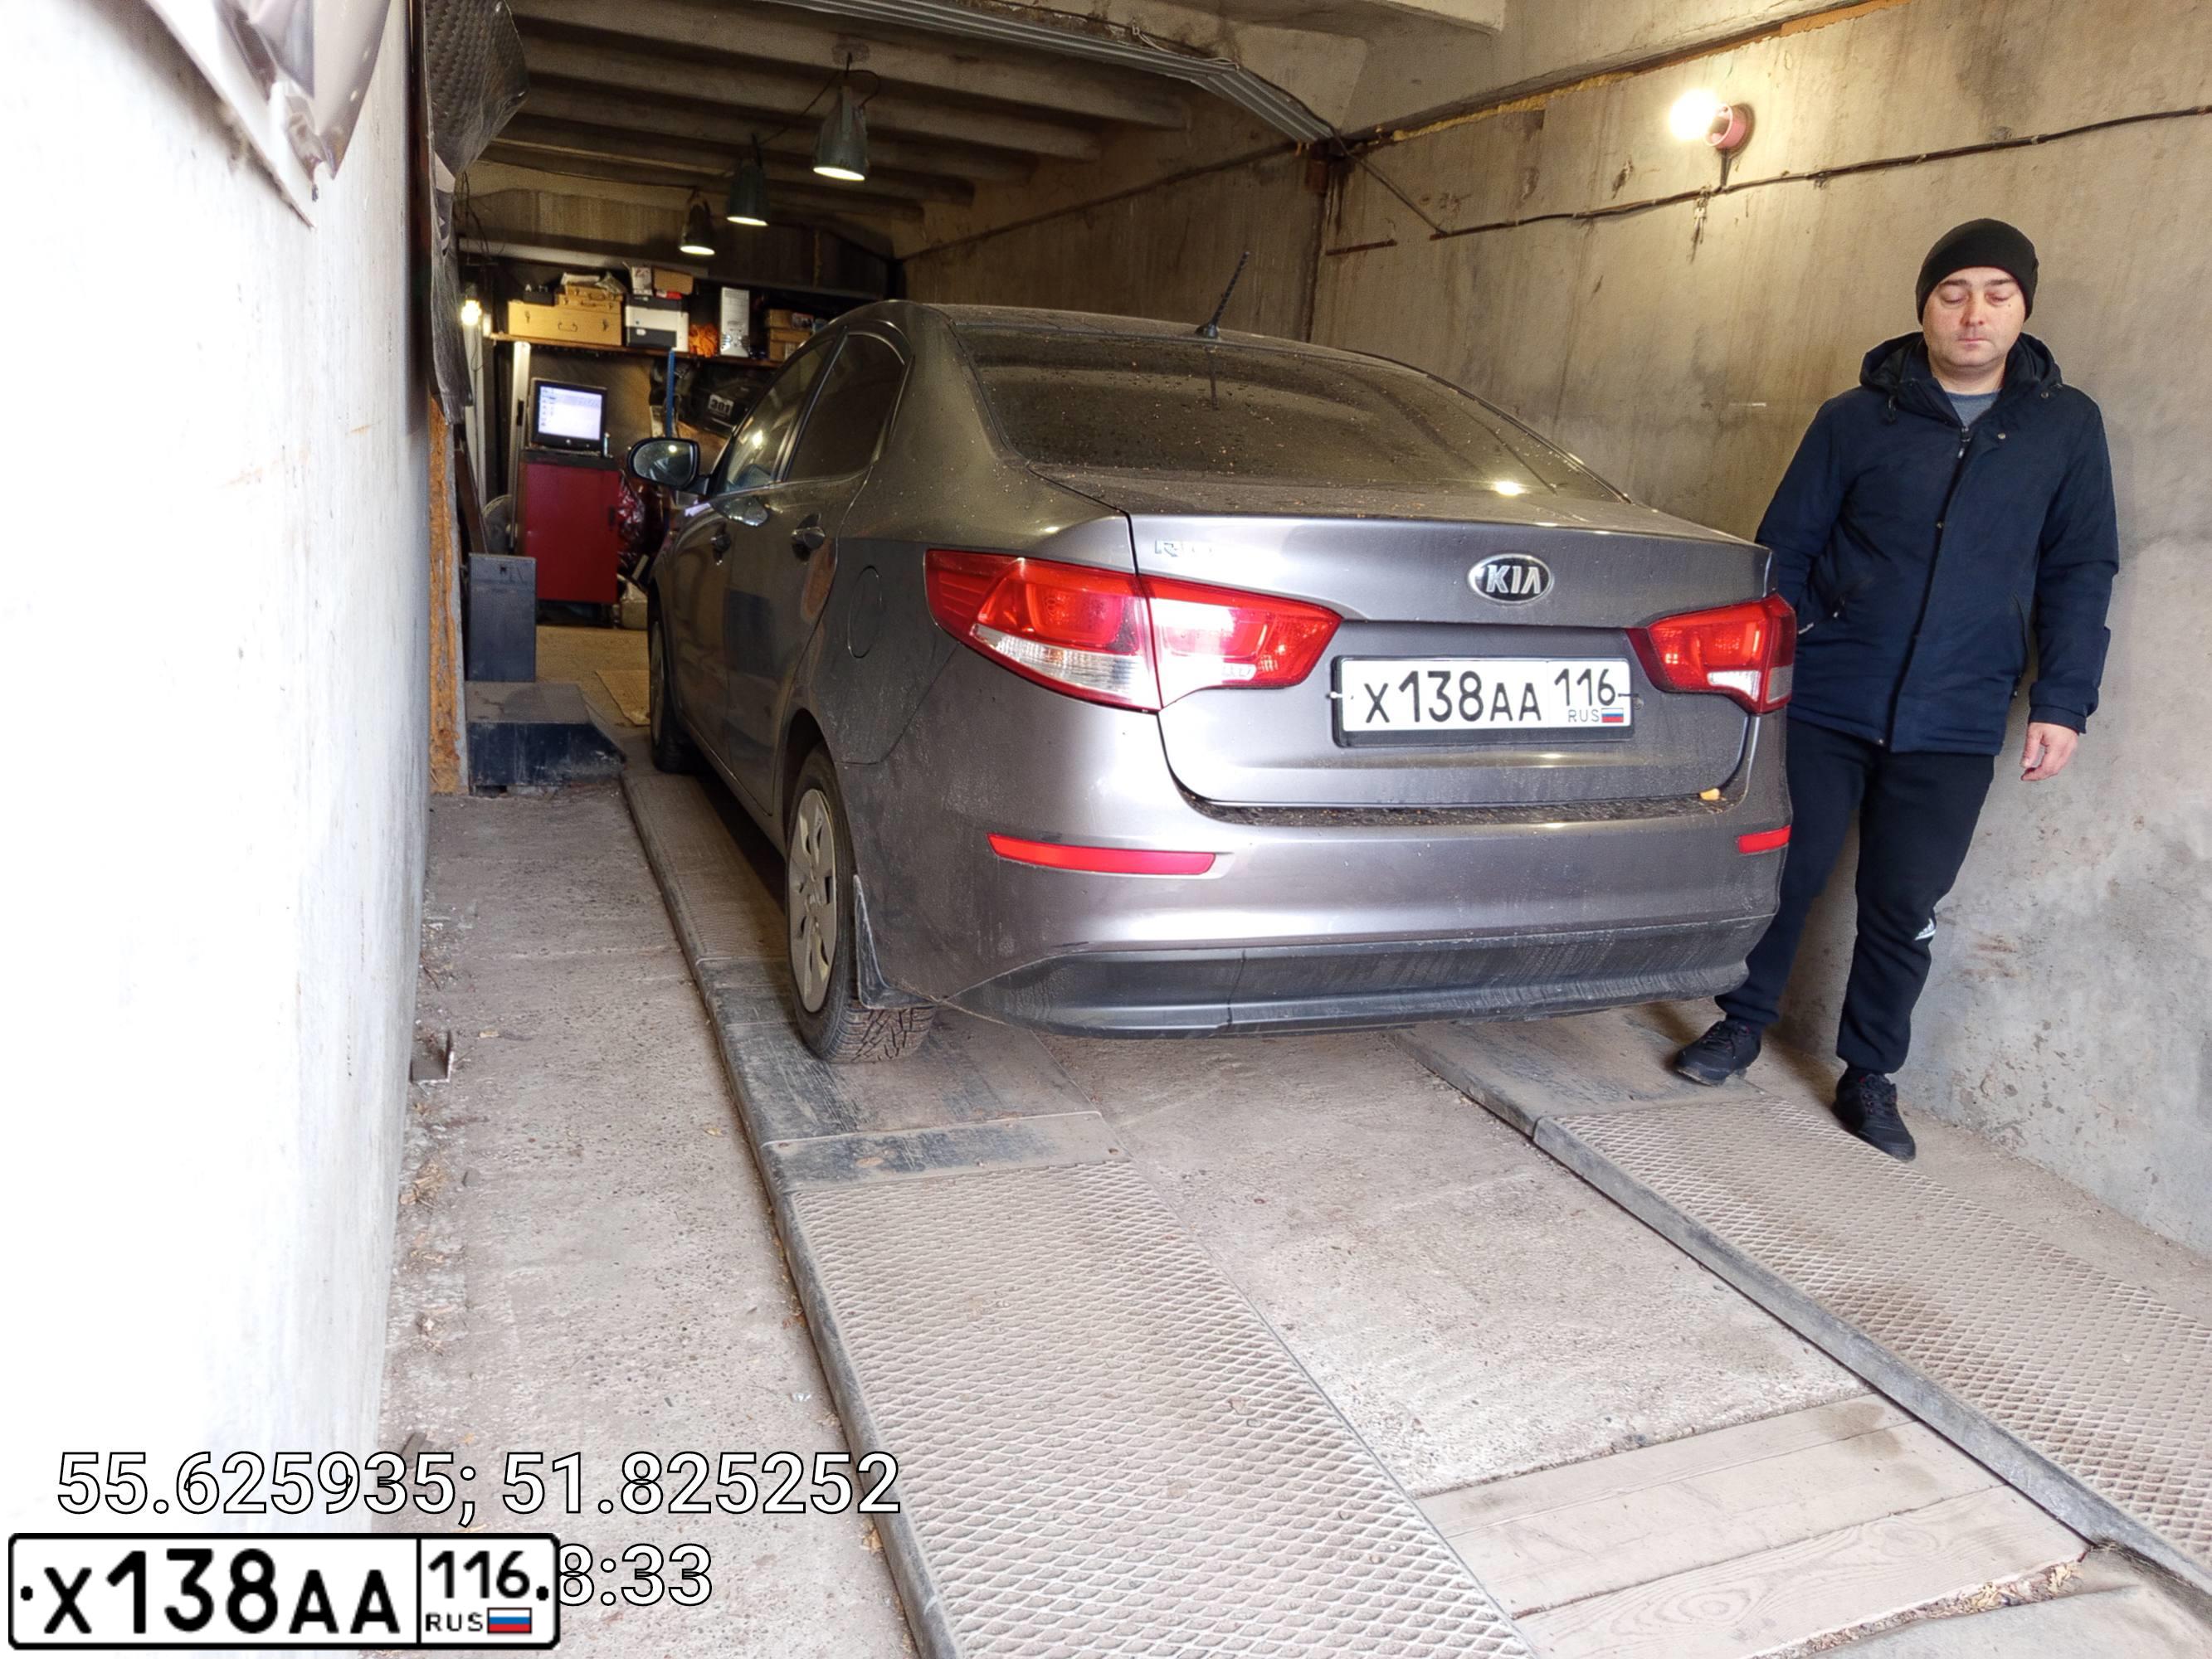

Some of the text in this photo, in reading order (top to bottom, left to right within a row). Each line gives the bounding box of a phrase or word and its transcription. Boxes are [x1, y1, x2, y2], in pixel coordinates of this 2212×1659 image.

[1486, 564, 1542, 594] KIA
[1553, 668, 1616, 707] 116
[1567, 708, 1601, 722] RUS
